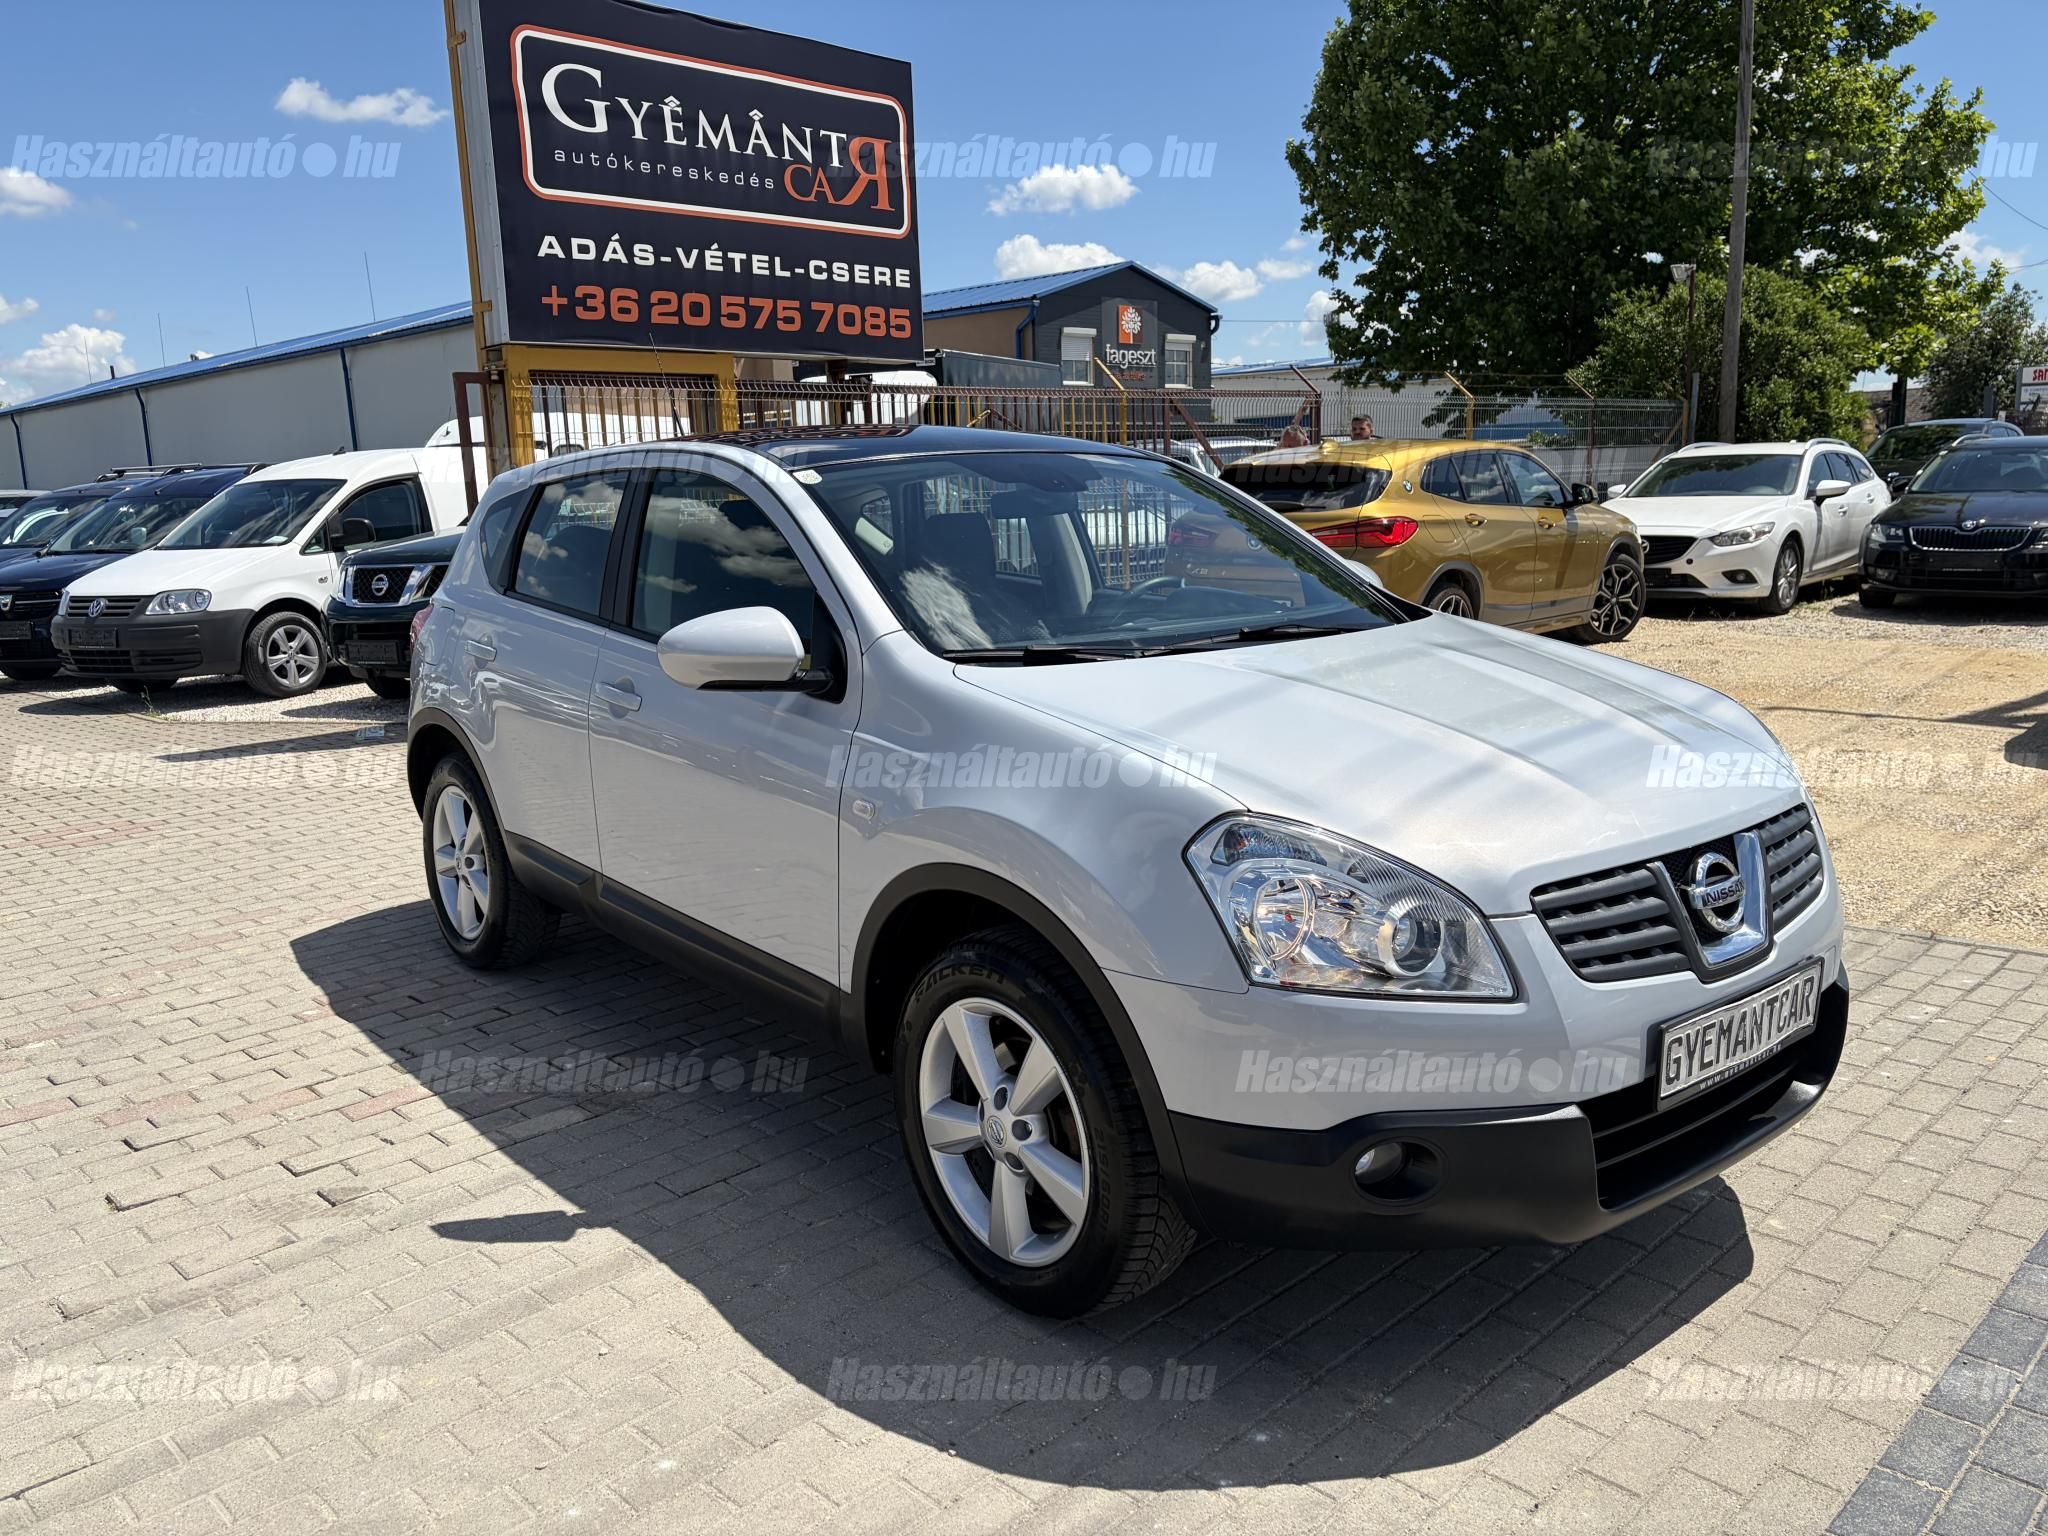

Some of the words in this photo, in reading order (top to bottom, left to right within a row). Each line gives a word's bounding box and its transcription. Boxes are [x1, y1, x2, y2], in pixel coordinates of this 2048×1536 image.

[554, 146, 775, 190] autókereskedés
[541, 284, 640, 324] +36
[650, 291, 711, 327] 20
[720, 295, 802, 333] 575
[811, 300, 912, 340] 7085
[1665, 976, 1815, 1086] GYEMANTCAR
